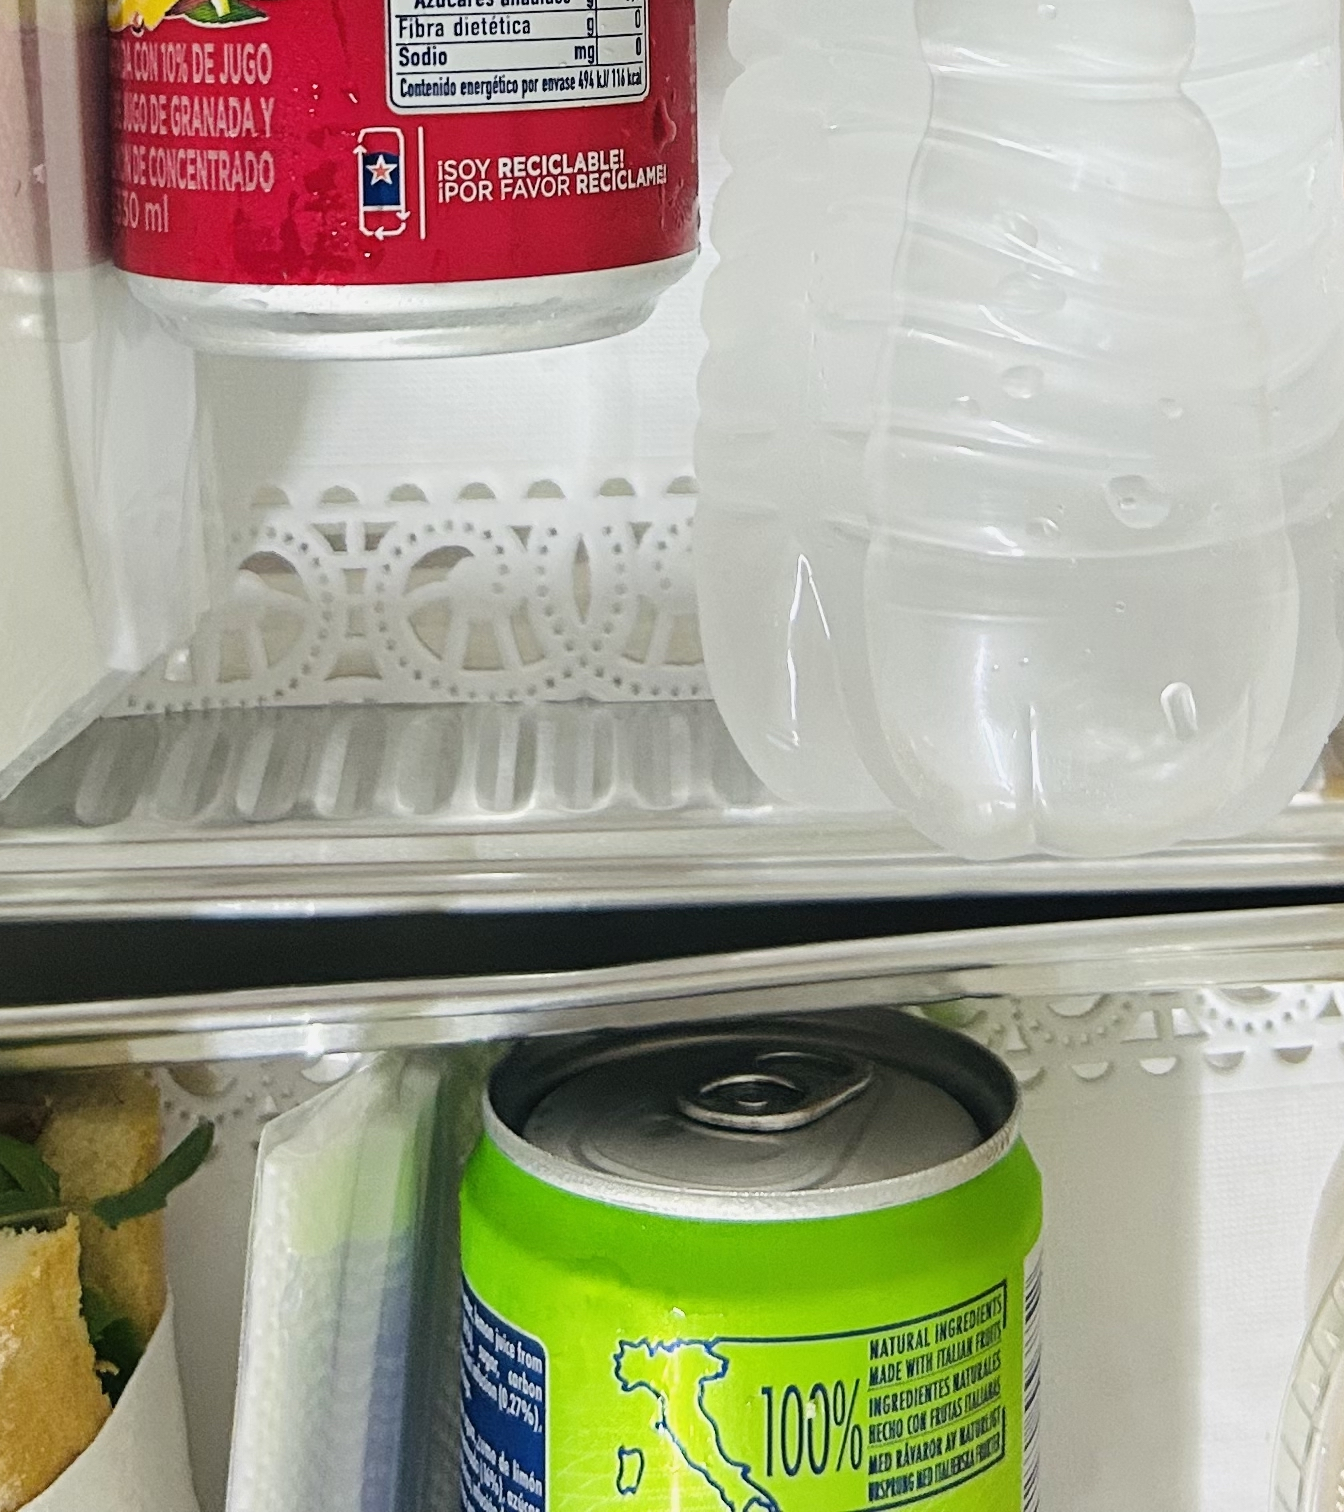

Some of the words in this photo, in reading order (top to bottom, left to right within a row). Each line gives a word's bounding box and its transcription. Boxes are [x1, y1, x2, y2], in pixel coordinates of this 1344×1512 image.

[398, 19, 445, 38] Fibra
[453, 16, 531, 35] dietética
[133, 41, 158, 81] CON
[161, 42, 188, 83] 10%
[192, 43, 215, 83] DE
[220, 43, 272, 84] JUGO
[399, 47, 448, 66] Sodio
[574, 44, 595, 64] mg
[400, 77, 456, 97] Contenido
[460, 75, 518, 100] energético
[578, 70, 594, 89] 494
[611, 68, 625, 88] 116
[150, 95, 167, 134] DE
[171, 95, 256, 137] GRANADA
[132, 145, 147, 185] DE
[149, 147, 275, 192] CONCENTRADO
[437, 158, 491, 181] ¡SOY
[498, 149, 624, 178] RECICLABLE!
[438, 181, 493, 203] ¡POR
[500, 176, 570, 200] FAVOR
[123, 190, 139, 228] 30
[145, 194, 169, 232] ml
[870, 1327, 930, 1360] NATURAL
[935, 1294, 1002, 1343] INGREDIENTS
[517, 1342, 542, 1374] from
[870, 1361, 902, 1386] MADE
[906, 1352, 933, 1379] WITH
[869, 1376, 950, 1417] INGREDIENTES
[953, 1349, 1001, 1391] NATURALES
[759, 1378, 863, 1478] 100%
[869, 1419, 903, 1444] HECHO
[512, 1459, 542, 1497] limón
